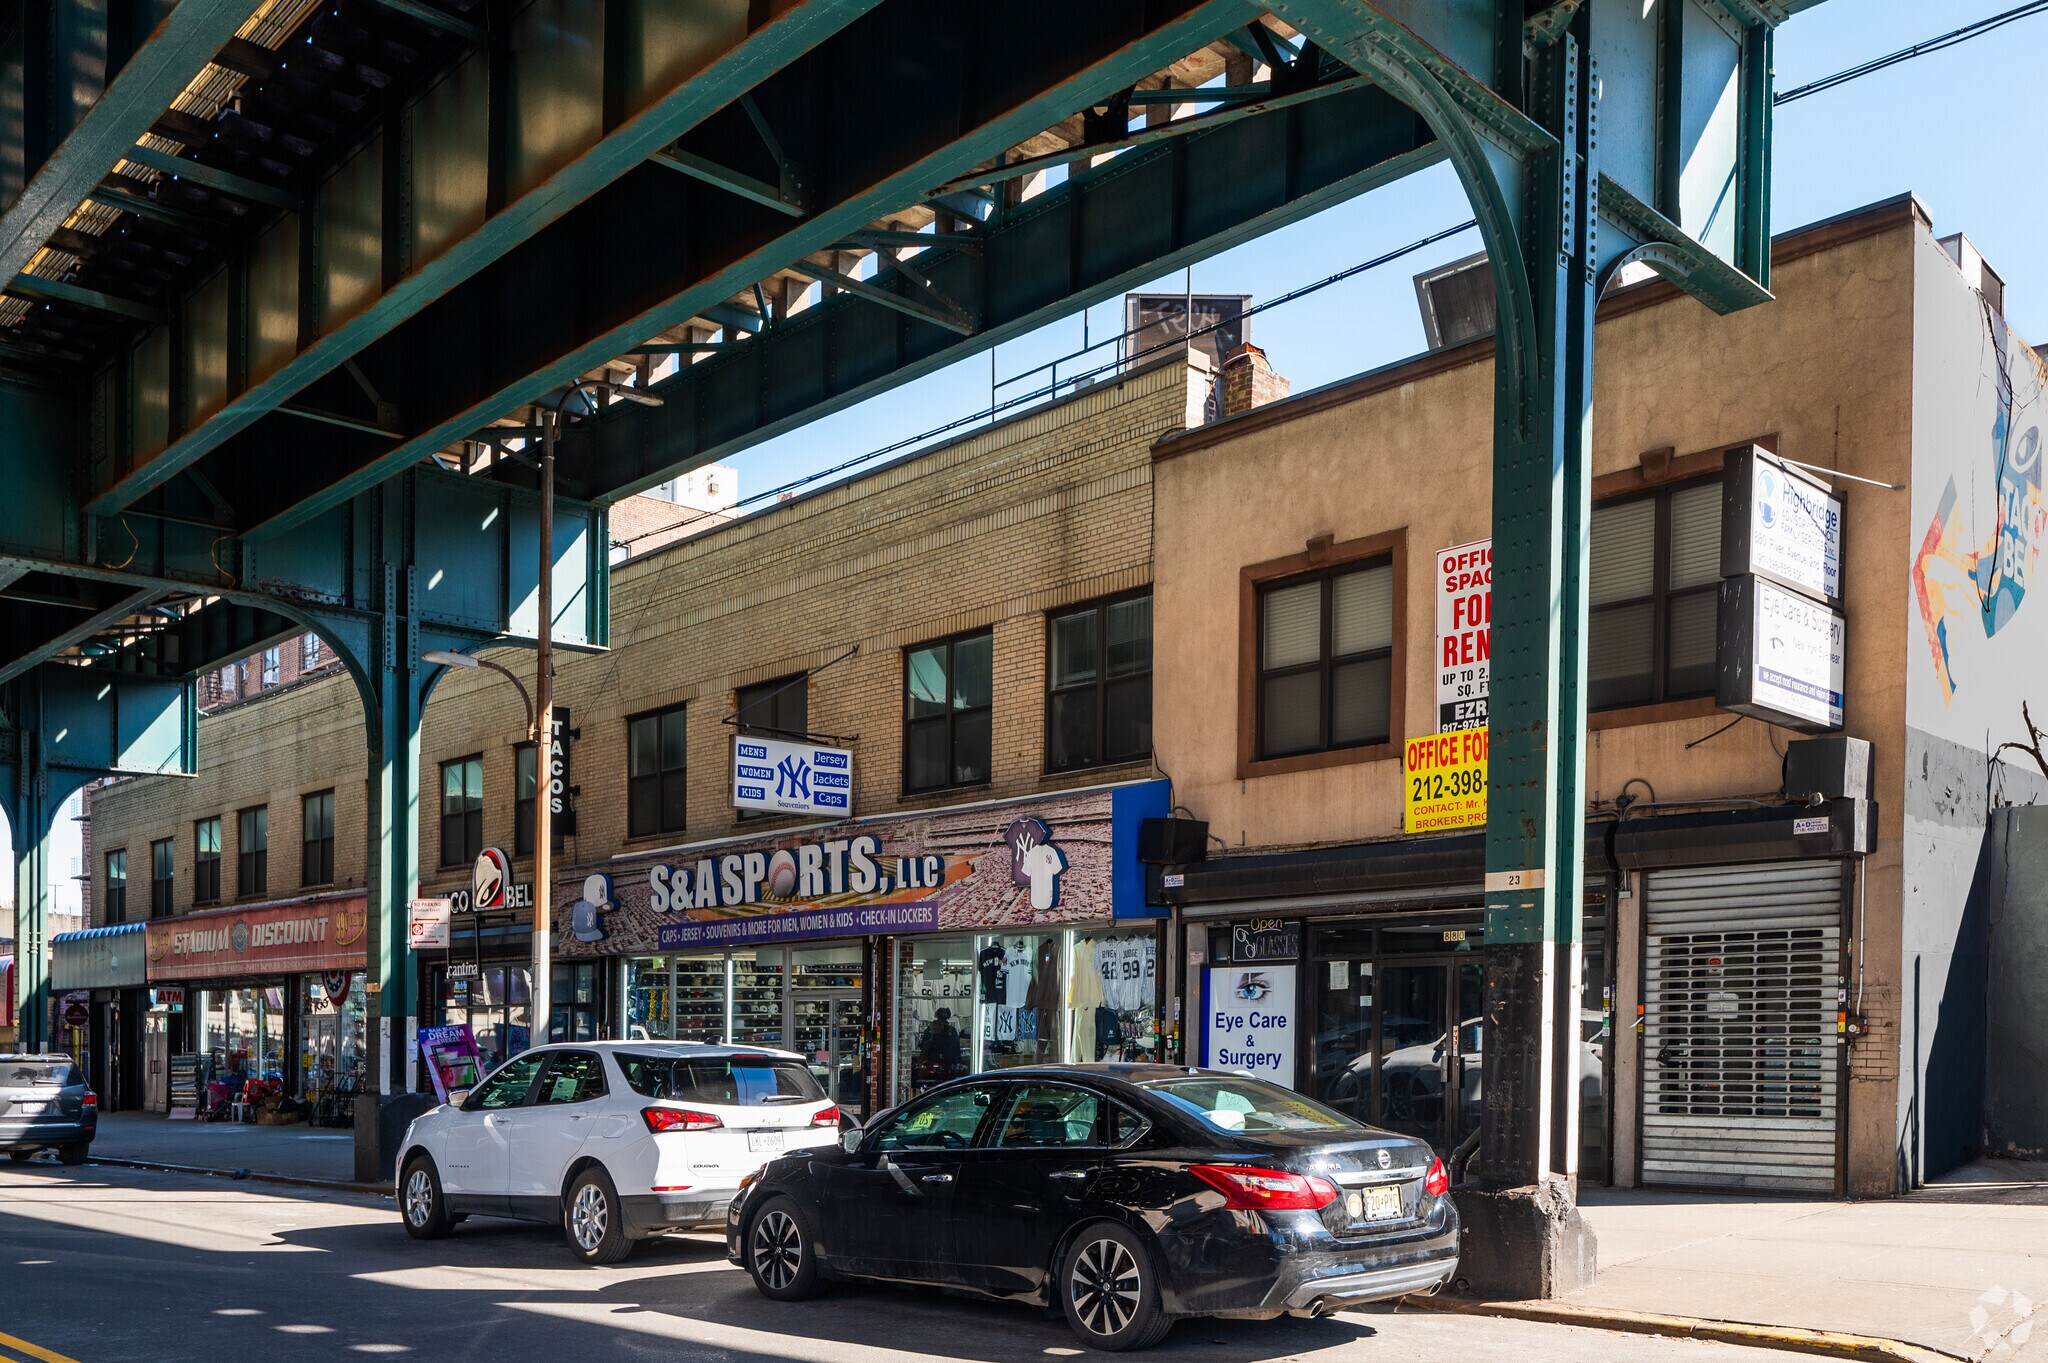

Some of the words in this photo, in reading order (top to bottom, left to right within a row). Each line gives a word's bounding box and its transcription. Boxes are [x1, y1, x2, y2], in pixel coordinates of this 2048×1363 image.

[1782, 481, 1836, 530] Highbridge
[1823, 561, 1836, 577] Floor
[1764, 588, 1779, 620] Eye
[1781, 595, 1801, 623] Care
[1811, 609, 1840, 645] Surgery
[1443, 671, 1456, 685] UP
[1460, 669, 1474, 682] TO
[1457, 684, 1475, 697] SQ.
[1455, 701, 1488, 720] EZR
[741, 747, 764, 757] MENS
[1408, 736, 1458, 772] OFFICE
[551, 720, 564, 813] TACOS
[816, 753, 846, 766] Jersey
[741, 767, 771, 778] WOMEN
[814, 774, 849, 786] Jackets
[741, 788, 762, 798] KIDS
[818, 793, 842, 805] Caps
[1414, 802, 1462, 816] CONTACT:
[1466, 800, 1480, 809] Mr.
[1416, 815, 1464, 829] BROKERS
[896, 856, 939, 888] LLC
[1509, 875, 1520, 885] 23
[661, 930, 678, 943] CAPS
[680, 927, 702, 941] JERSEY
[706, 923, 741, 940] SOUVENIRS
[742, 923, 747, 936] &
[747, 921, 767, 936] MORE
[768, 920, 781, 933] FOR
[782, 918, 799, 933] MEN,
[800, 914, 828, 931] WOMEN
[829, 915, 835, 928] &
[836, 912, 853, 927] KIDS
[860, 909, 896, 926] CHECK-IN
[897, 907, 933, 924] LOCKERS
[1250, 918, 1283, 933] Open
[174, 924, 229, 960] STADIUM
[251, 917, 328, 947] DISCOUNT
[1444, 931, 1465, 941] 880
[1255, 933, 1299, 957] GLASSES
[1123, 949, 1138, 959] JUDGE
[448, 962, 478, 976] cantina
[1009, 959, 1020, 967] NEW
[1101, 959, 1117, 980] 42
[1122, 960, 1140, 980] 99
[1147, 959, 1155, 977] 2
[158, 990, 183, 1003] ATM
[943, 985, 950, 996] 2
[1215, 1012, 1244, 1033] Eye
[1249, 1011, 1287, 1029] Care
[428, 1029, 465, 1040] DREAM
[1246, 1034, 1255, 1047] &
[1219, 1048, 1282, 1070] Surgery
[1308, 1162, 1342, 1171] AIMA
